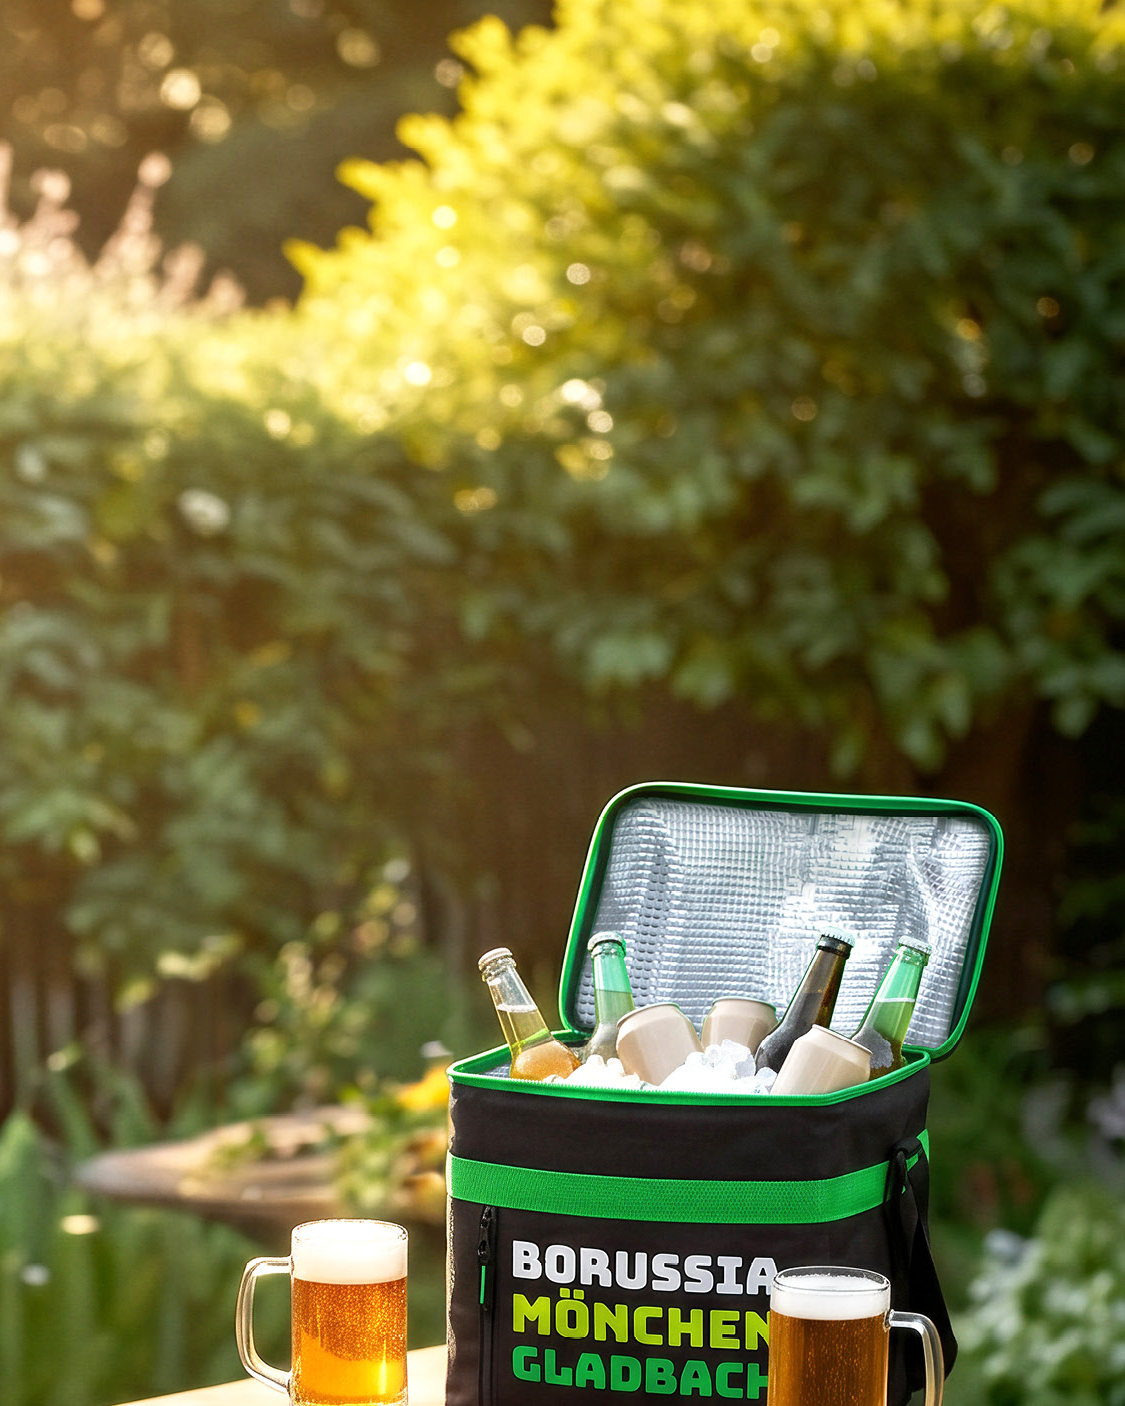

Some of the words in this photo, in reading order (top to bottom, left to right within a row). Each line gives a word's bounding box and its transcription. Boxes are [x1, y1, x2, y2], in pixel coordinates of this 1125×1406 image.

[512, 1240, 777, 1295] BORUSSIA
[512, 1287, 771, 1350] MÖNCHEN
[512, 1345, 769, 1399] GLADBACH
